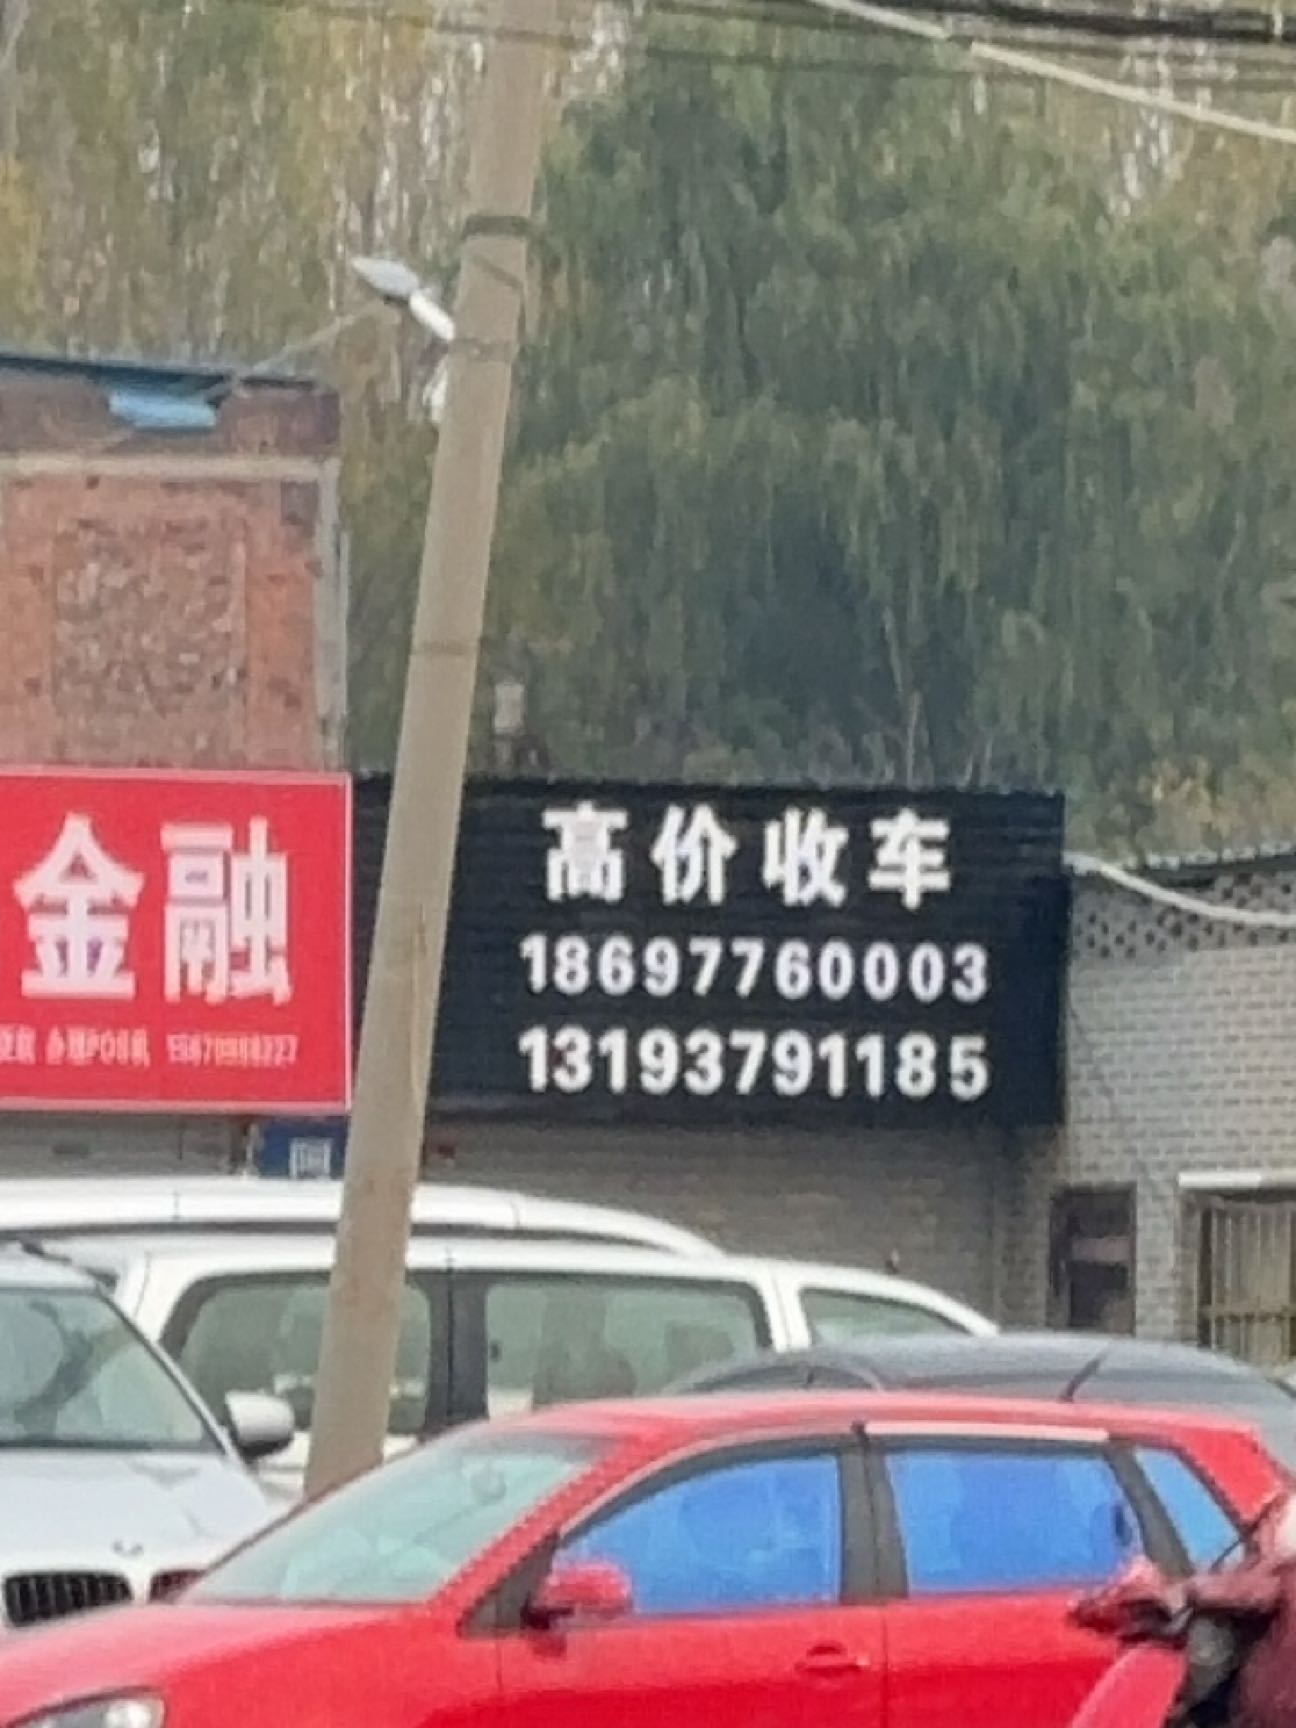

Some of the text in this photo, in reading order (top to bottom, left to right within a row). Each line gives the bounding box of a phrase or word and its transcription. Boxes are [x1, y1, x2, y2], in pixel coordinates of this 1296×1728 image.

[541, 801, 952, 909] 高价收车
[519, 933, 990, 1003] 18697760003
[518, 1025, 991, 1102] 13193791185
